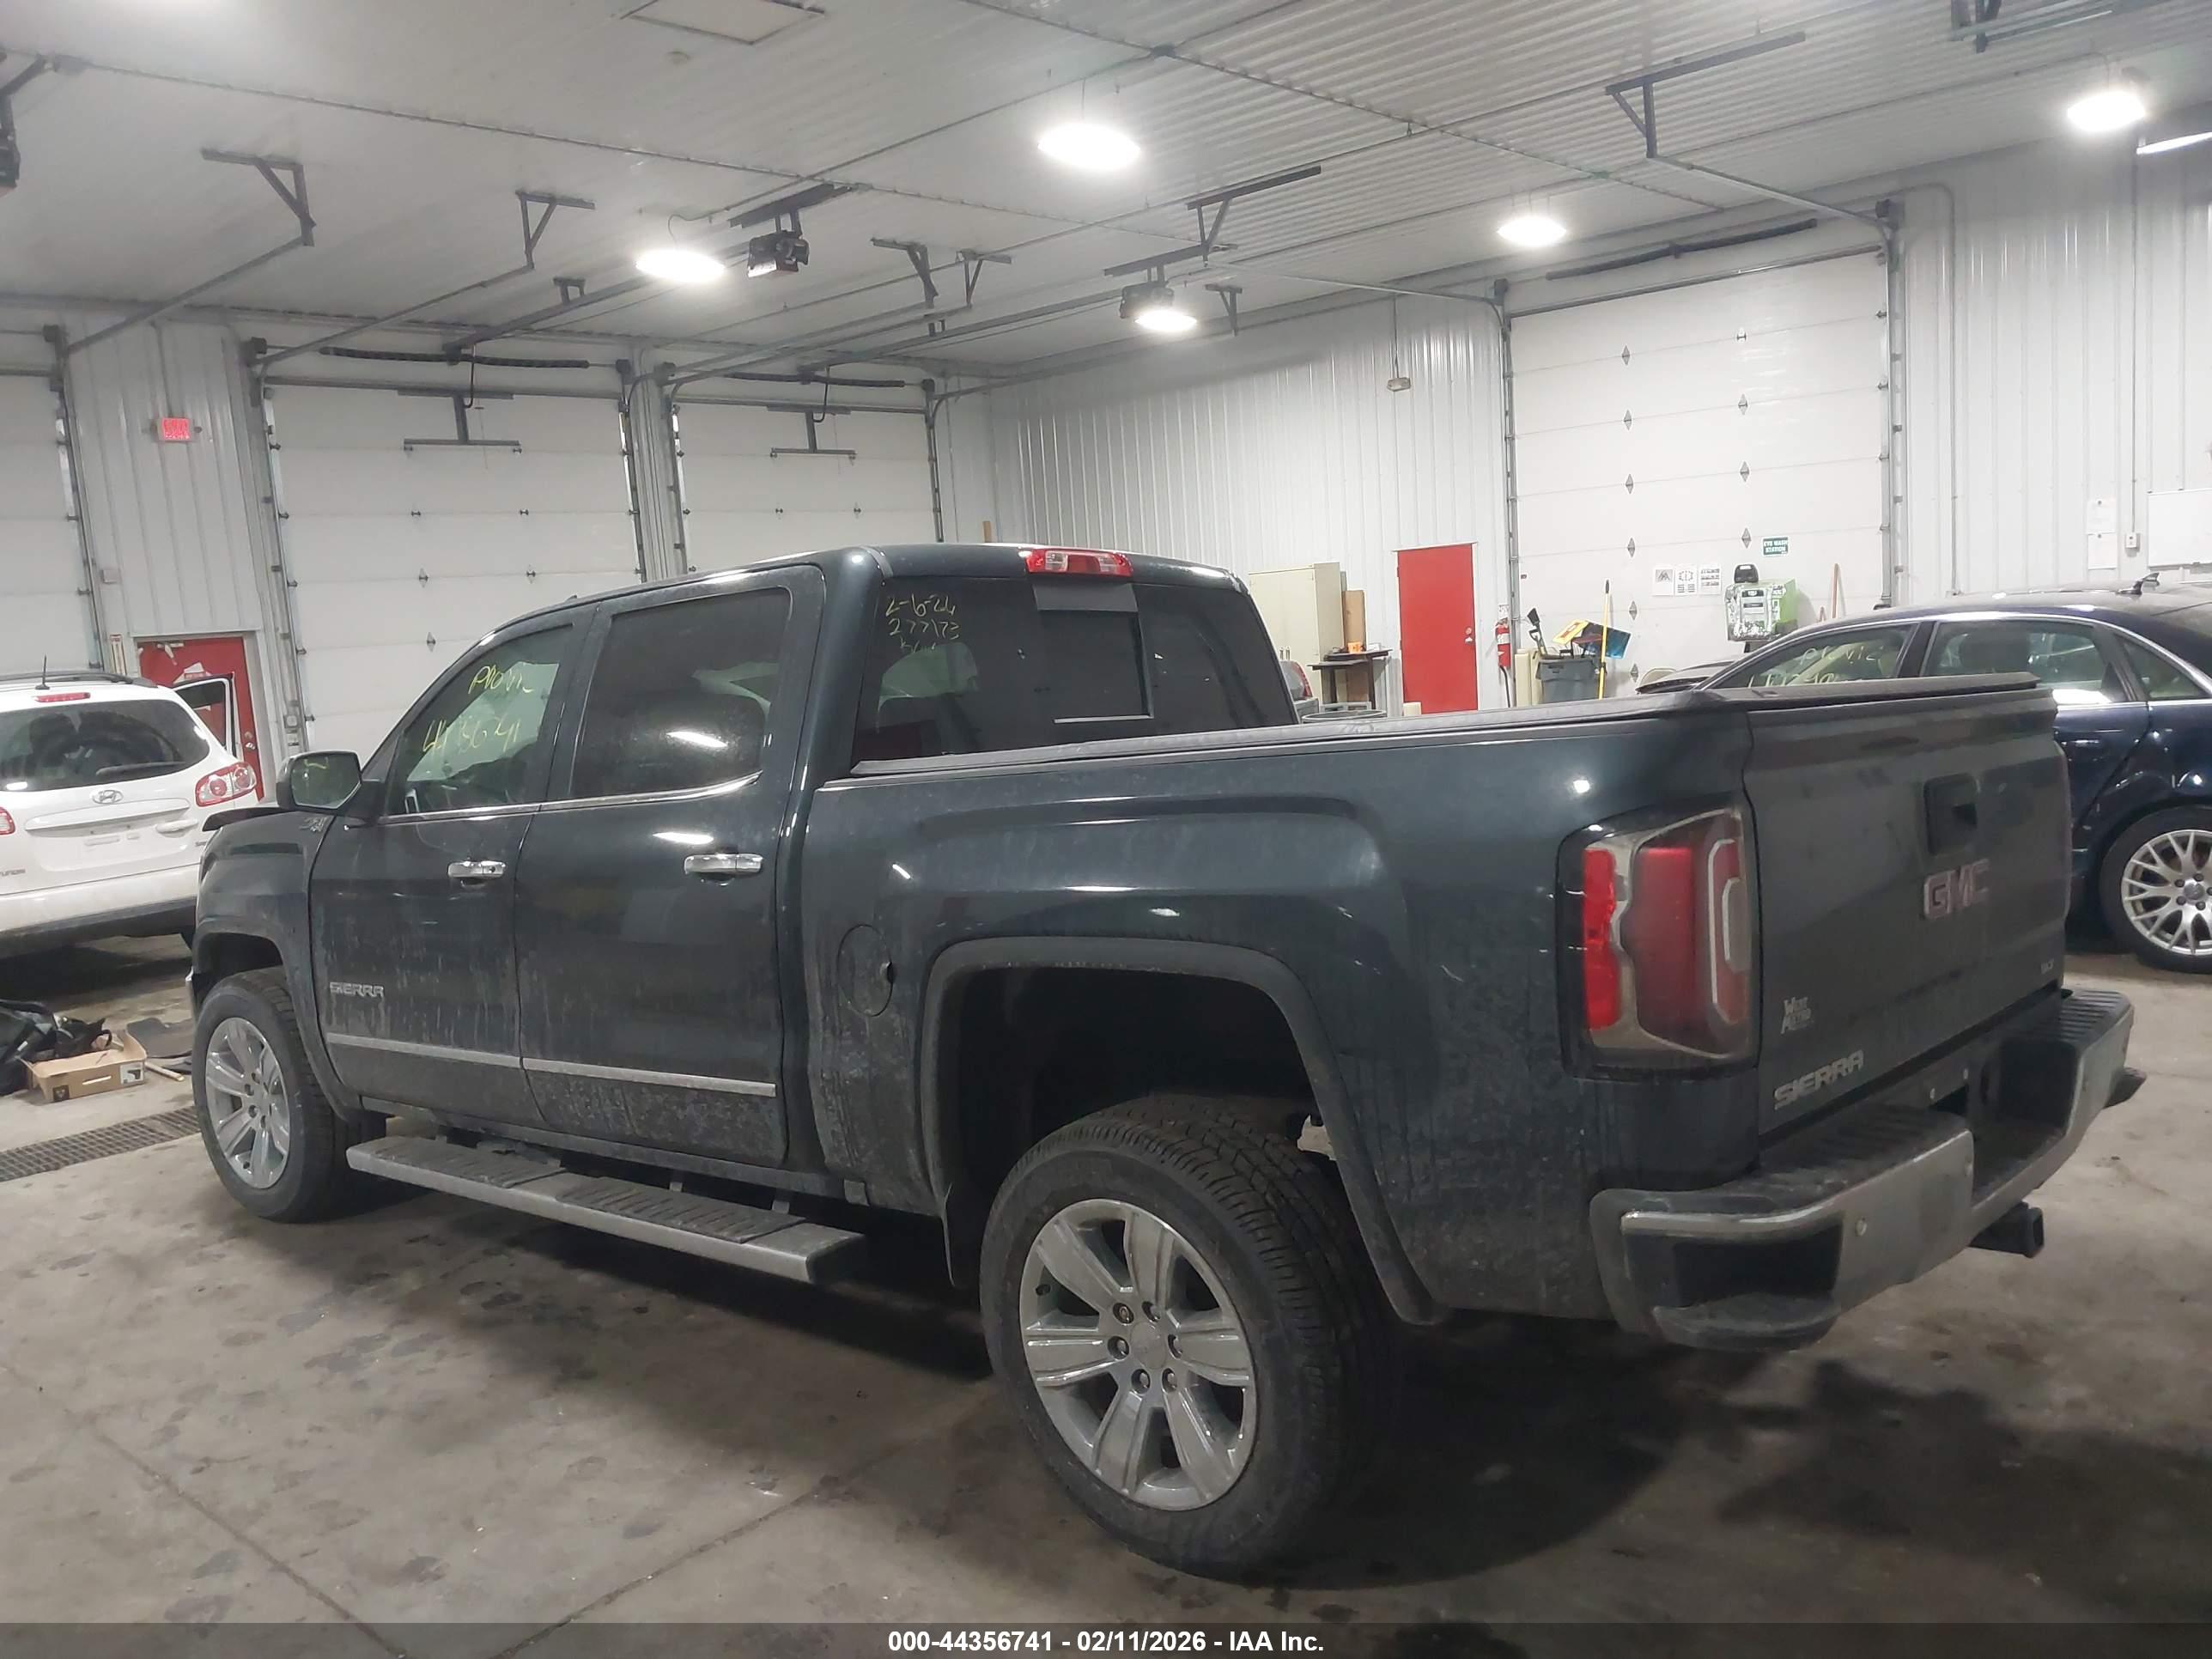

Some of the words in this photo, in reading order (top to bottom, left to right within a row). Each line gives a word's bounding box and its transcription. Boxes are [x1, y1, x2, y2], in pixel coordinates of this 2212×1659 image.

[1923, 858, 1990, 921] GMC
[329, 981, 385, 998] SIERRA
[1773, 1049, 1864, 1111] SIERRA
